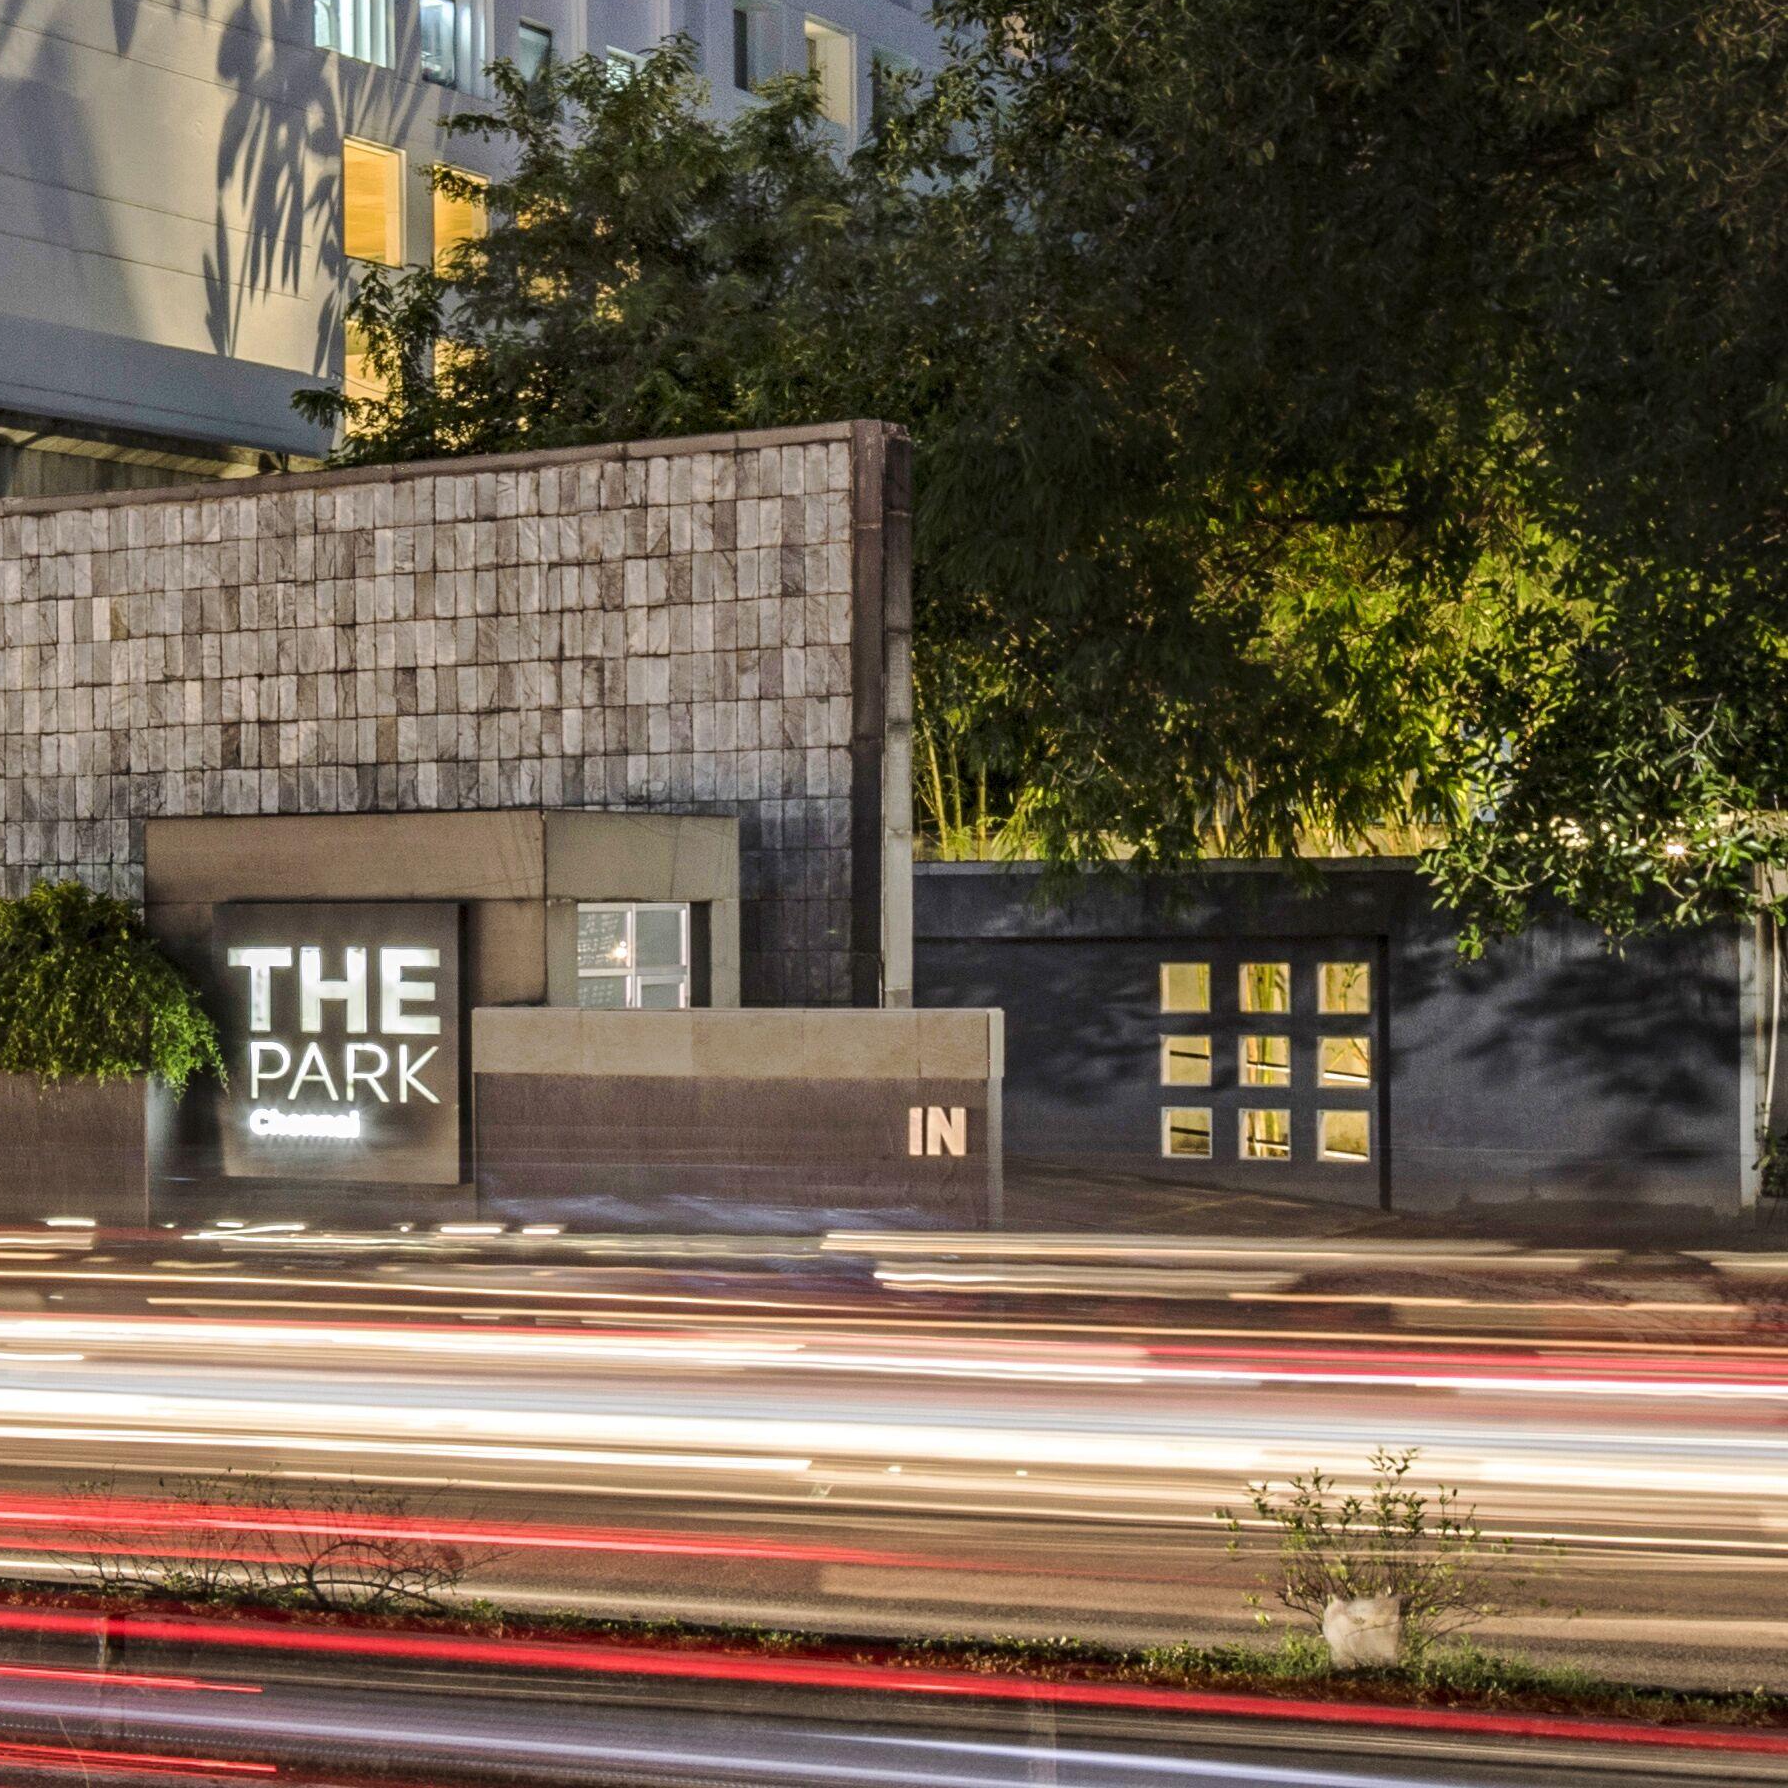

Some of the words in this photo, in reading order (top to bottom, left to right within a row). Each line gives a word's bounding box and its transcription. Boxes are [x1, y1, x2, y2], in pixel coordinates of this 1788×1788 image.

[228, 946, 441, 1034] THE
[250, 1041, 441, 1103] PARK
[909, 1106, 967, 1156] IN
